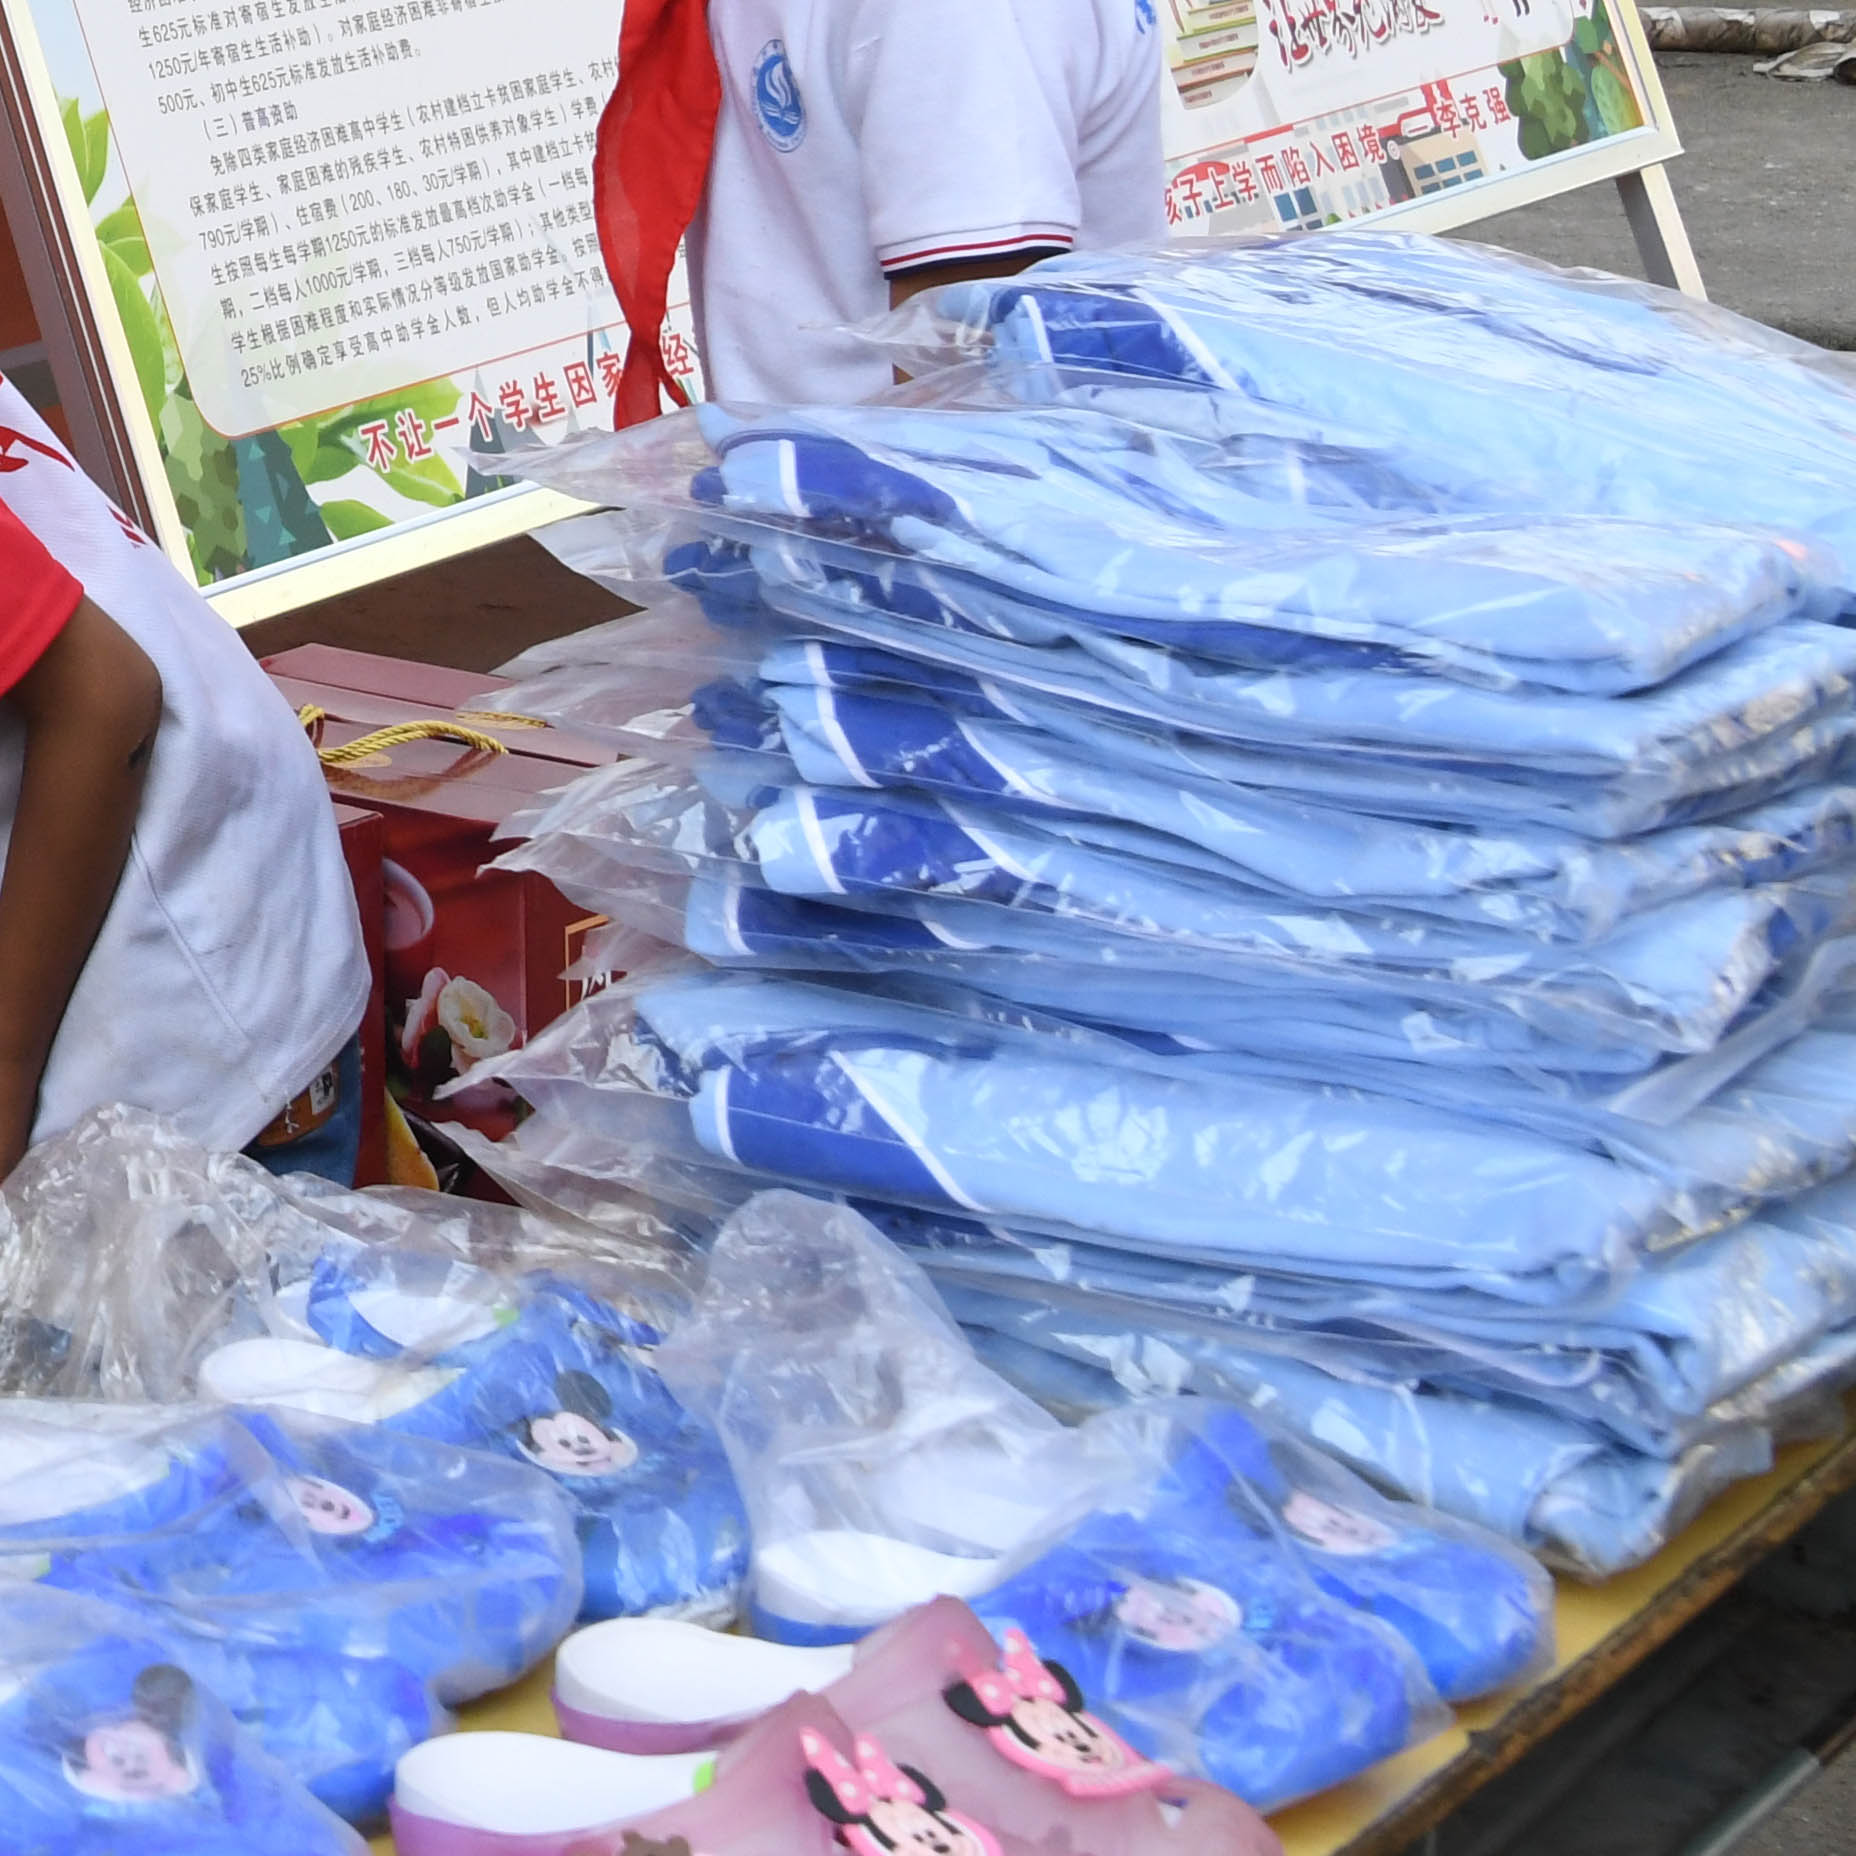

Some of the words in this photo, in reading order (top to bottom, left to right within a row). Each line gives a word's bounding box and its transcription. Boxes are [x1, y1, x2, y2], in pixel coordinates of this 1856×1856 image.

[202, 100, 300, 142] （三）普高资助
[207, 59, 621, 178] 免除四类家庭经济困难高中学生（农村建档立卡贫困家庭学生、农村
[358, 331, 695, 473] 不让一个学生因家经
